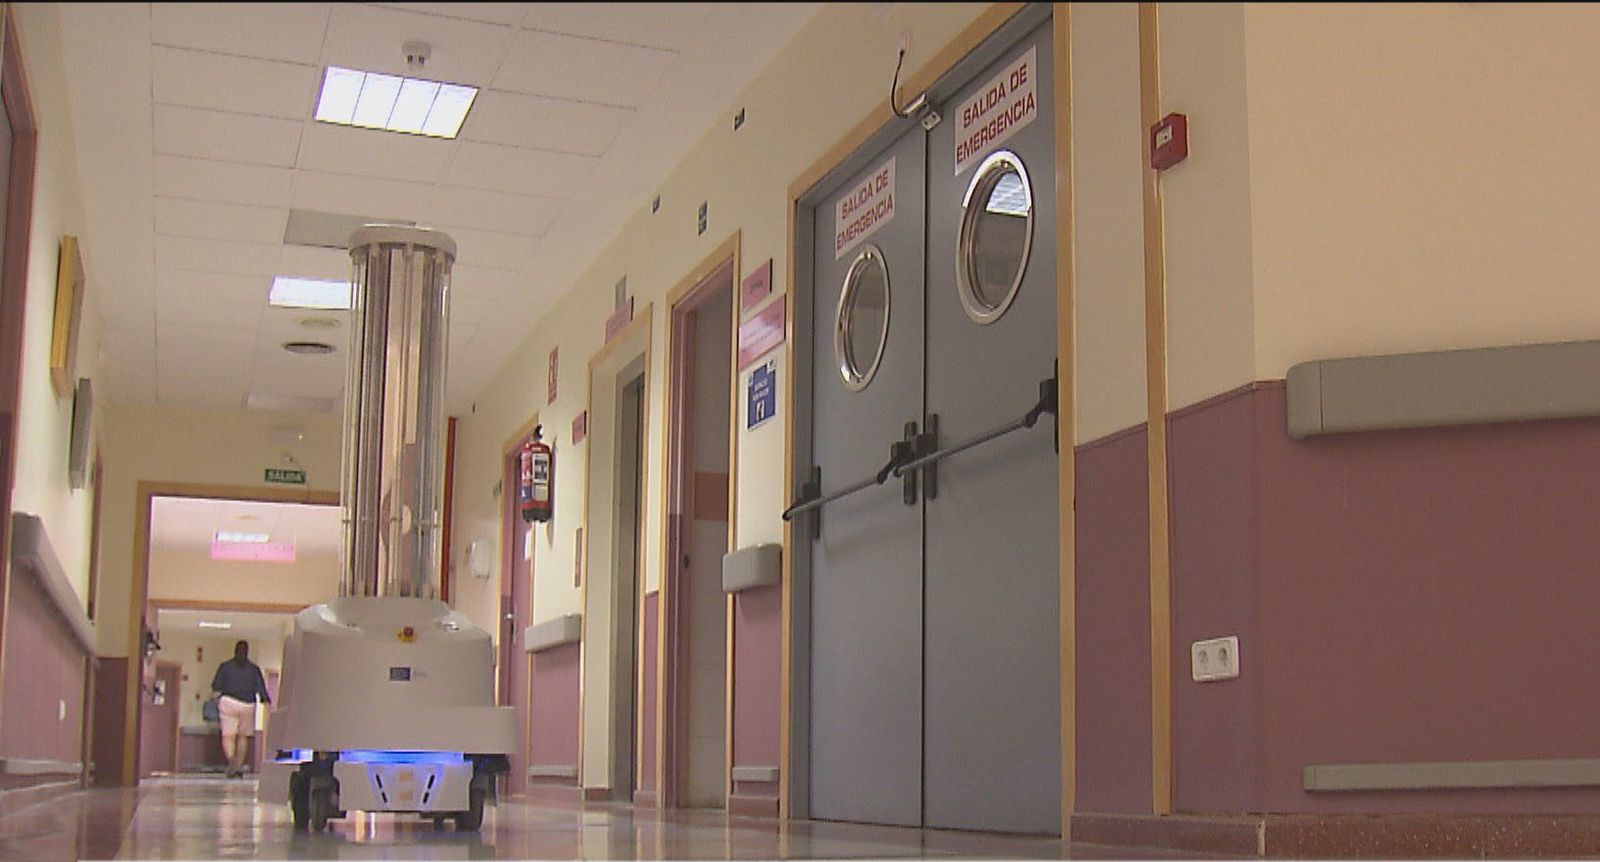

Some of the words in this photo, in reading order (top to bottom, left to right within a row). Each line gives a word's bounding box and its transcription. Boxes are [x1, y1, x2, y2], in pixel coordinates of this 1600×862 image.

[963, 82, 1006, 128] SALIDA
[1010, 63, 1027, 92] DE
[956, 91, 1035, 164] EMERGENCIA
[837, 194, 893, 250] EMERGENCIA
[842, 181, 873, 220] SALIDA
[876, 168, 888, 193] DE
[267, 470, 302, 481] SALIDA
